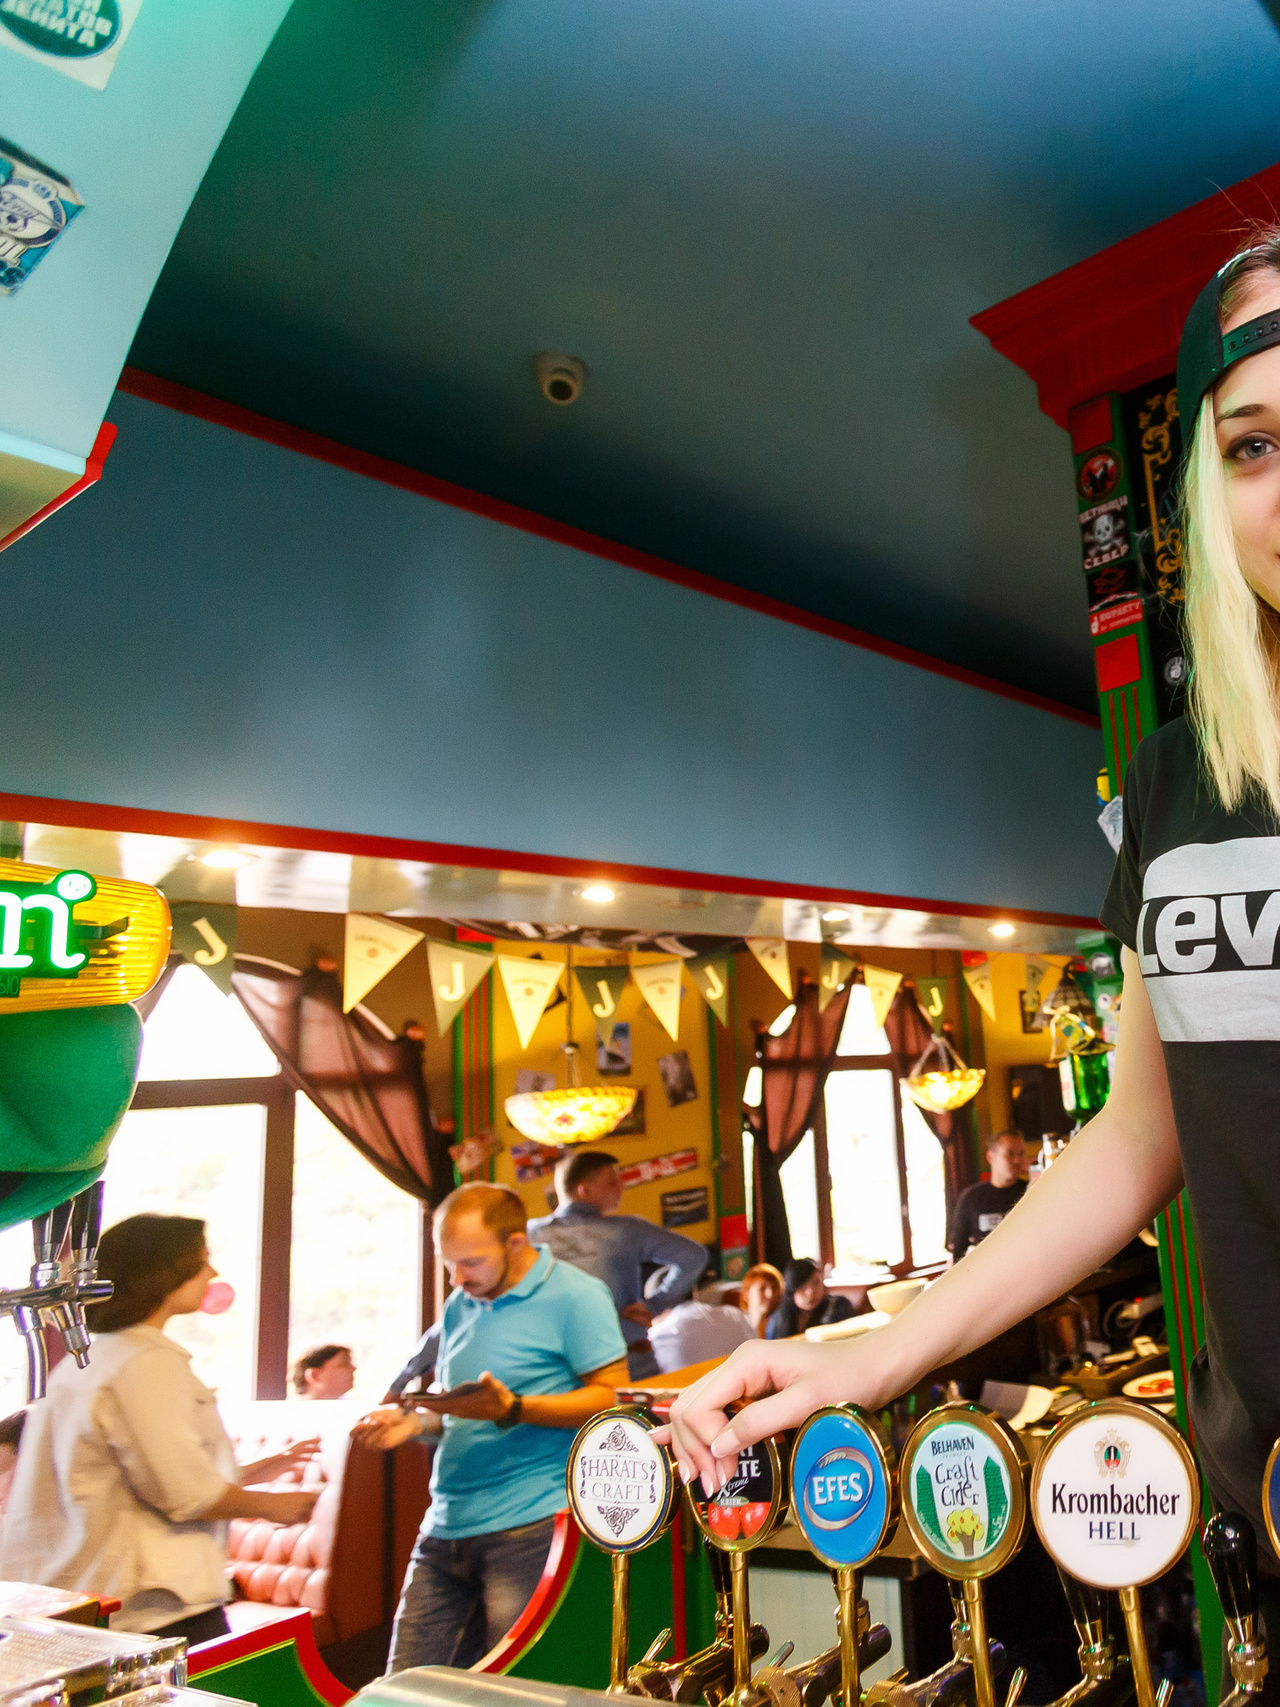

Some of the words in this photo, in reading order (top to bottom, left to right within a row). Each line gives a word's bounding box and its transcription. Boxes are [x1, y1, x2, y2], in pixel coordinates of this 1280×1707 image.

[191, 917, 229, 967] J
[437, 960, 466, 1002] J
[704, 965, 725, 1001] J
[821, 960, 840, 990] J
[592, 979, 615, 1018] J
[928, 986, 944, 1017] J
[931, 1435, 975, 1457] BELHAVEN
[935, 1455, 980, 1484] Craft
[592, 1482, 644, 1500] CRAFT
[716, 1477, 750, 1502] Xtreme
[720, 1497, 742, 1506] KRIEK
[811, 1472, 864, 1506] EFES
[1051, 1483, 1181, 1516] Krombacher
[1088, 1521, 1141, 1541] HELL
